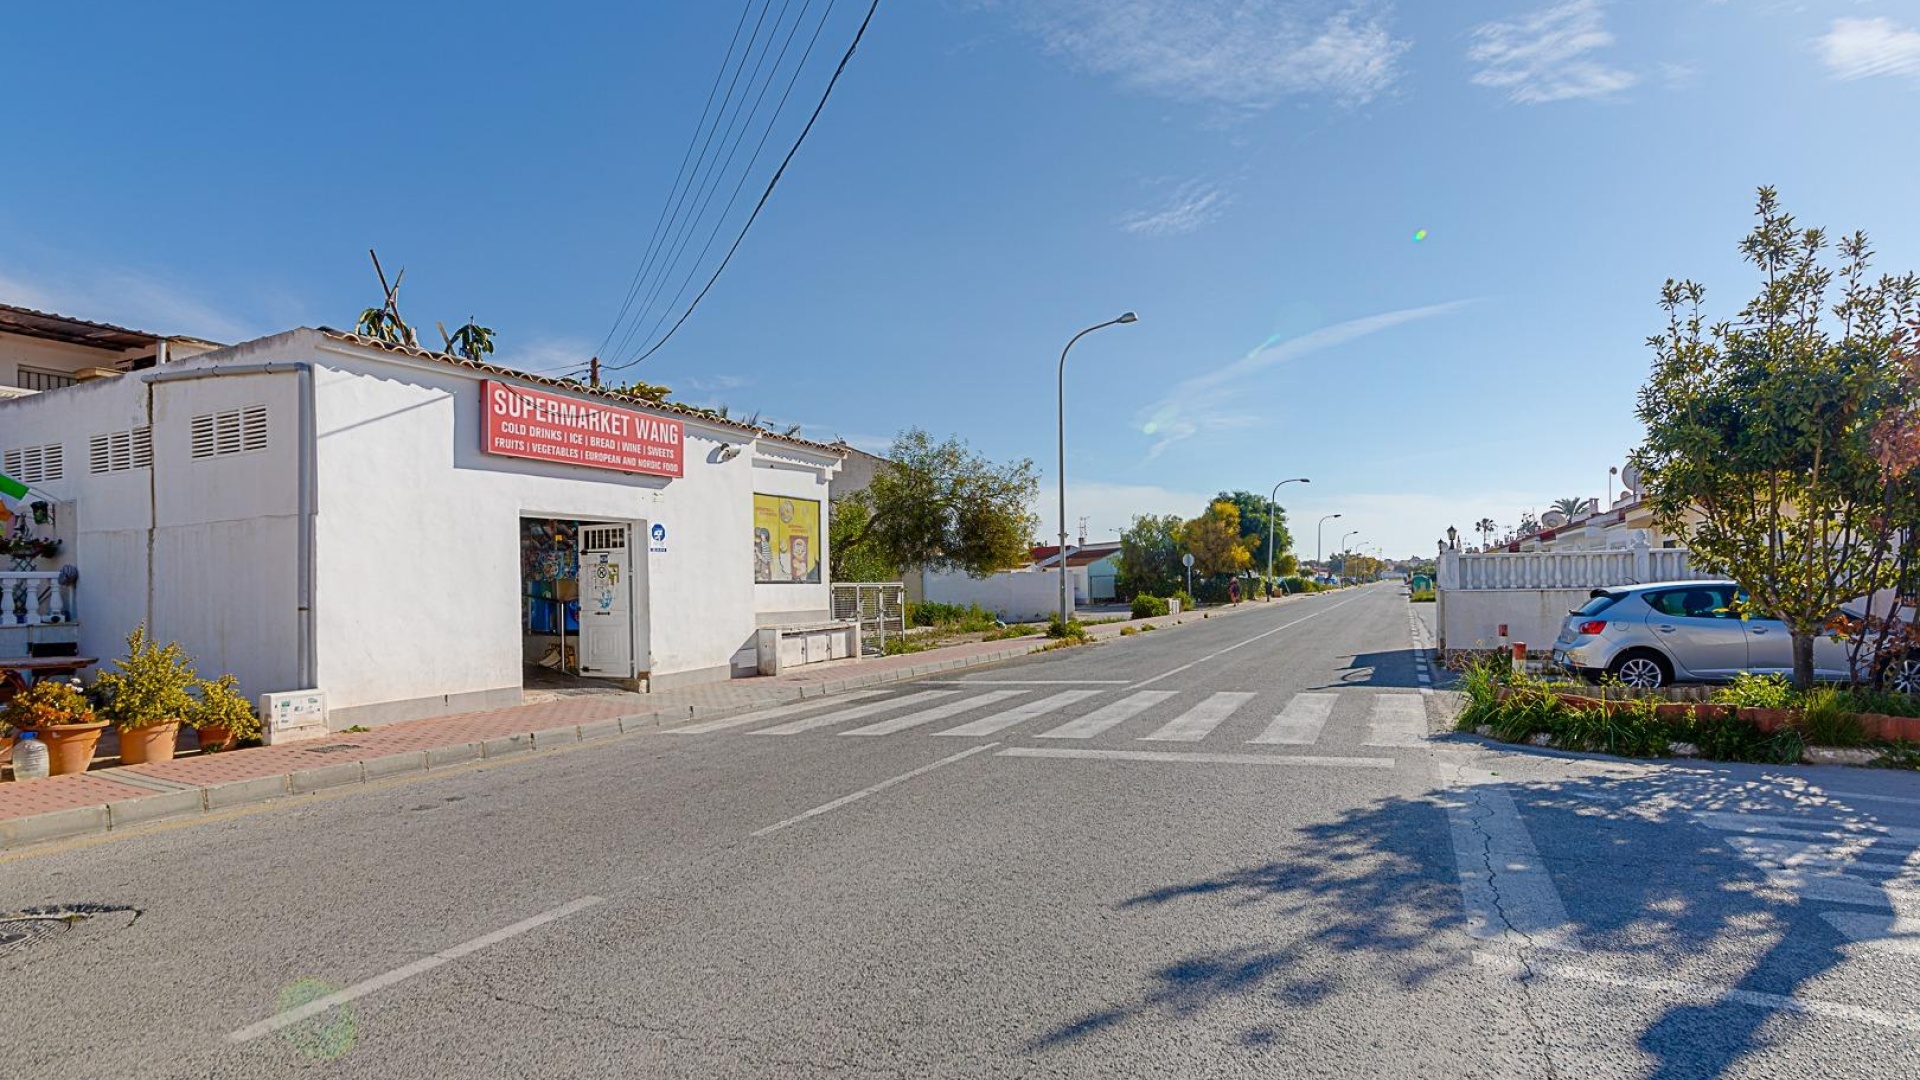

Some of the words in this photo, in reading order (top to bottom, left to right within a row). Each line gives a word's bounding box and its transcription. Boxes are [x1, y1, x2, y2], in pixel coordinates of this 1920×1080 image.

[494, 389, 630, 436] SUPERMARKET
[635, 417, 679, 445] WANG
[494, 437, 524, 450] FRUITS
[532, 443, 578, 459] VEGETABLES
[585, 450, 621, 464] EUROPEAN
[622, 456, 636, 466] AND
[638, 458, 661, 470] NORDIC
[662, 461, 678, 472] FOOD
[501, 421, 526, 436] COLD
[530, 426, 562, 441] DRINKS
[570, 434, 583, 445] ICE
[590, 436, 615, 450] BREAD
[622, 442, 642, 454] WINE
[647, 446, 674, 458] SWEETS
